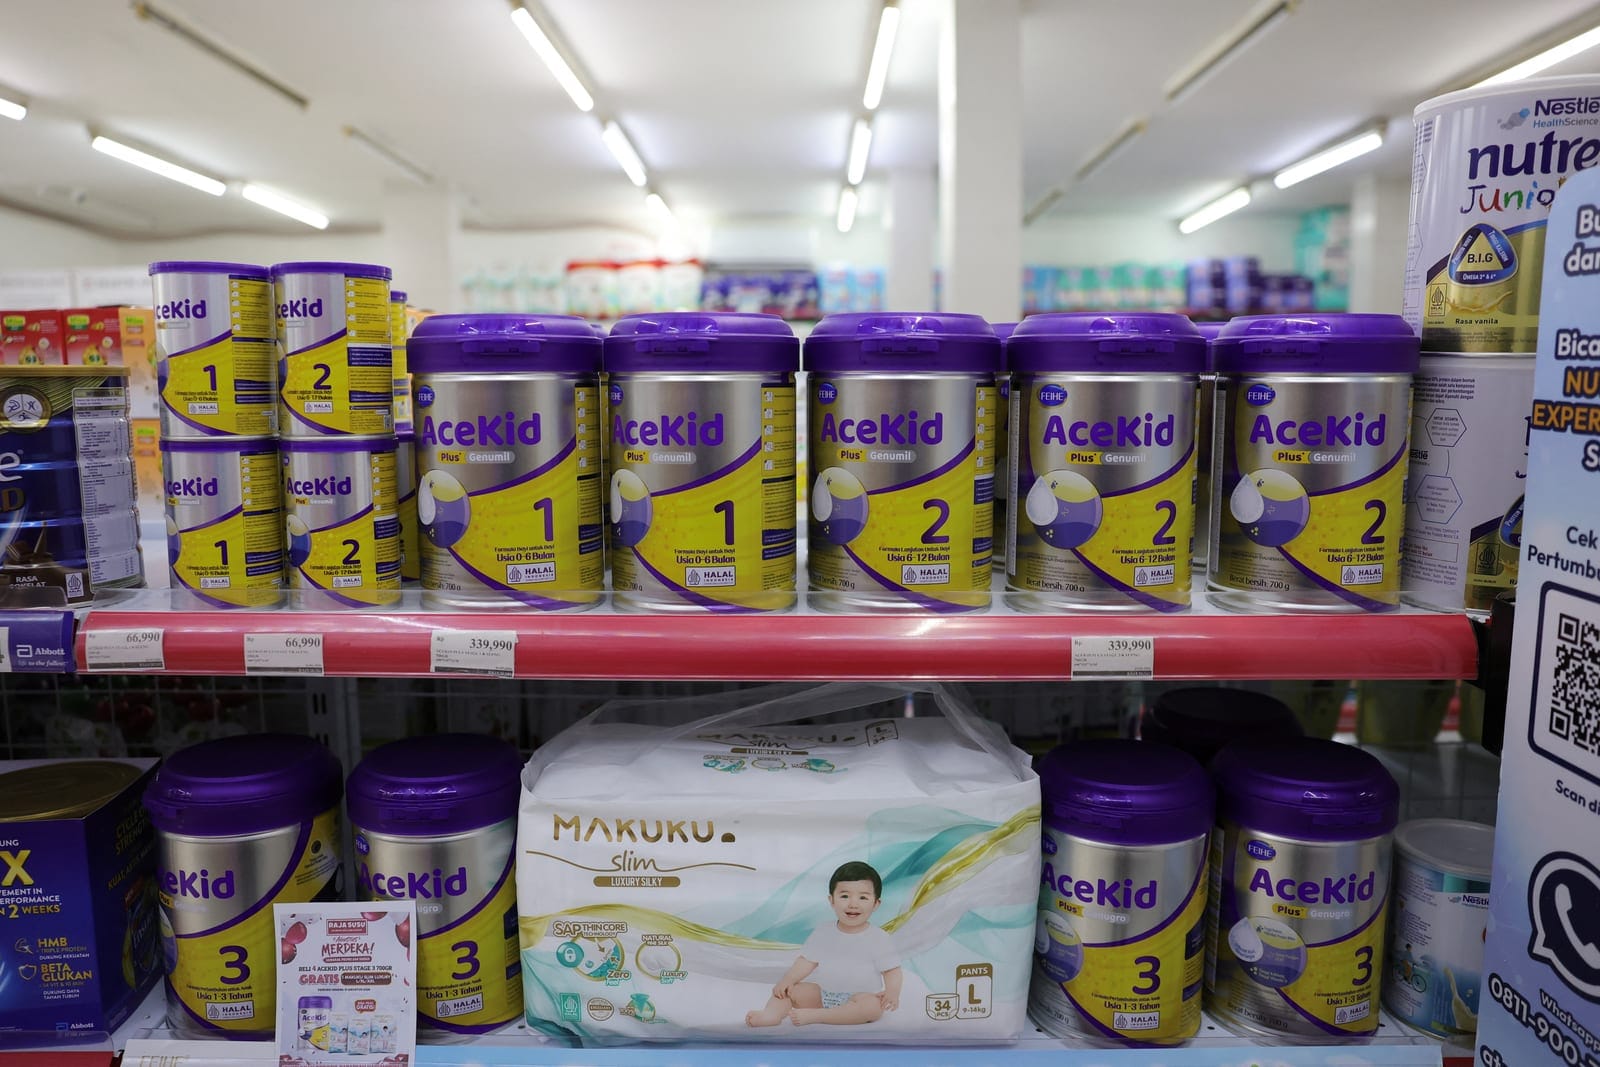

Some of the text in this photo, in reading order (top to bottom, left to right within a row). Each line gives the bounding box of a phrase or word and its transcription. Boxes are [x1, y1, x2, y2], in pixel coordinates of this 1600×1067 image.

[1533, 117, 1599, 129] HealthScience
[1460, 181, 1560, 214] Junio
[1467, 253, 1493, 263] B.I.G
[203, 364, 217, 391] 1
[313, 363, 332, 390] 2
[818, 389, 835, 399] FEIHE
[1041, 391, 1064, 401] FEIHE
[1248, 391, 1272, 401] FEIHE
[422, 411, 541, 446] AceKid
[612, 411, 724, 446] AceKid
[821, 410, 943, 445] AceKid
[1043, 412, 1174, 447] AceKid
[1250, 412, 1386, 447] AceKid
[441, 453, 510, 462] Plus Genumil
[627, 452, 692, 462] Plus Genumil
[840, 450, 911, 461] Plus Genumil
[1070, 453, 1146, 463] Plus Genumil
[1278, 452, 1356, 463] Plus Genumil
[286, 477, 351, 496] AceKid
[534, 498, 554, 542] 1
[714, 500, 734, 545] 1
[921, 499, 950, 544] 2
[1152, 500, 1177, 545] 2
[1361, 499, 1386, 545] 2
[1566, 526, 1598, 550] Cek
[214, 540, 228, 566] 1
[342, 539, 361, 565] 2
[497, 553, 515, 562] Usia
[532, 551, 555, 560] Bulan
[887, 554, 905, 562] Usia
[928, 553, 950, 561] Bulan
[676, 556, 694, 564] Usia
[712, 556, 736, 564] Bulan
[1120, 555, 1138, 564] Usia
[1158, 554, 1176, 563] Bulan
[1327, 554, 1346, 563] Usia
[525, 567, 554, 575] HALAL
[920, 568, 948, 576] HALAL
[1150, 569, 1173, 577] HALAL
[1358, 568, 1382, 576] HALAL
[1269, 581, 1283, 590] 700
[285, 637, 320, 648] 66,990
[470, 638, 512, 651] 339,990
[1108, 640, 1151, 651] 339,990
[35, 647, 65, 656] Abbott
[1555, 779, 1586, 807] Scan
[1248, 844, 1273, 858] FEIHE
[611, 851, 658, 872] slim
[359, 863, 467, 899] AceKid
[611, 877, 663, 887] LUXURY SILKY
[1041, 862, 1157, 909] AceKid
[1250, 868, 1375, 904] AceKid
[8, 904, 60, 918] 2 WEEKS
[1058, 901, 1077, 914] Plus
[1277, 905, 1301, 917] Plus
[555, 923, 581, 936] SAP
[38, 938, 67, 948] HMB
[322, 942, 375, 957] MERDEKA!
[219, 945, 250, 984] 3
[451, 941, 480, 980] 3
[1352, 946, 1373, 985] 3
[41, 963, 70, 972] BETA
[961, 967, 988, 975] PANTS
[42, 970, 92, 982] GLUKAN
[299, 974, 340, 985] GRATIS
[608, 971, 629, 979] Zero
[1132, 956, 1161, 994] 3
[229, 991, 252, 999] Tahun
[460, 985, 482, 996] Tahun
[969, 984, 981, 1004] L
[454, 998, 480, 1009] HALAL
[934, 1000, 951, 1011] 34
[1104, 1001, 1122, 1010] Usia
[1139, 1001, 1160, 1009] Tahun
